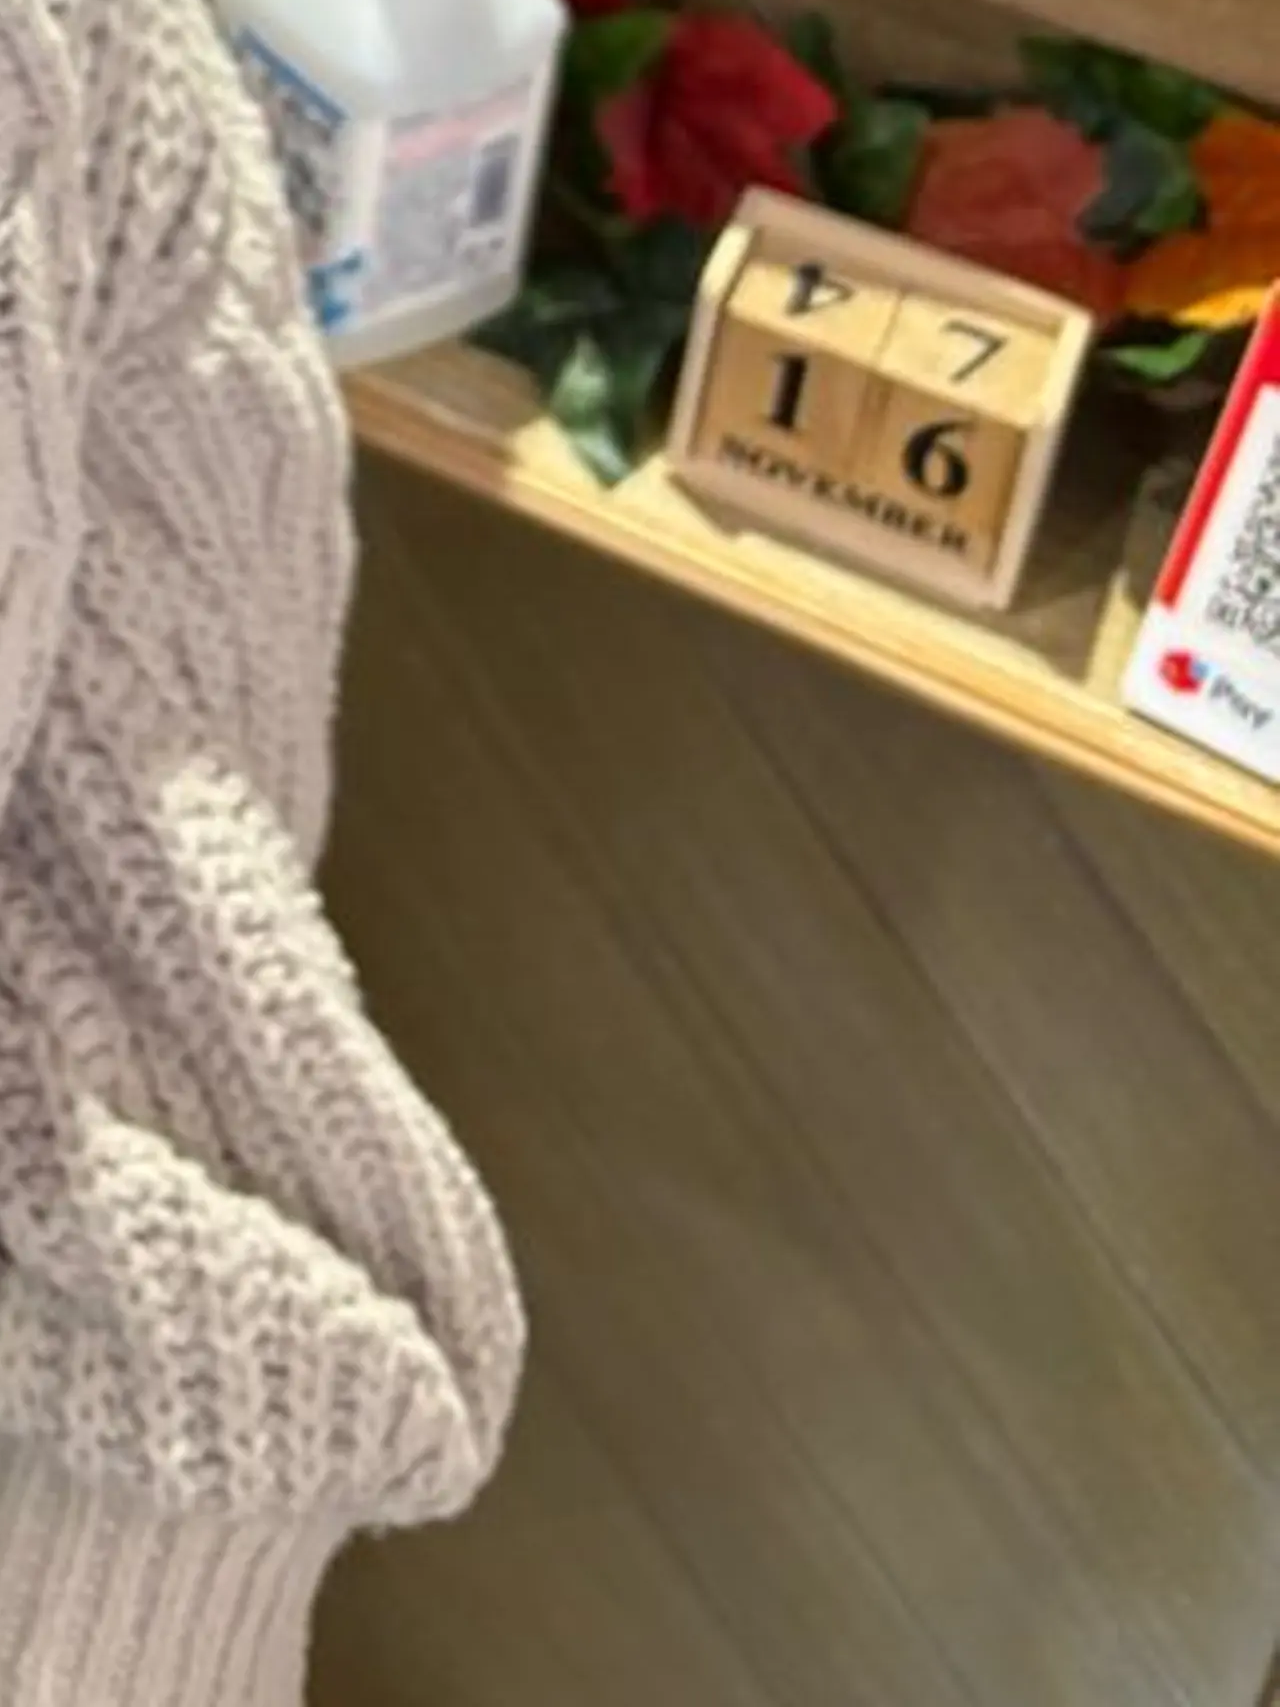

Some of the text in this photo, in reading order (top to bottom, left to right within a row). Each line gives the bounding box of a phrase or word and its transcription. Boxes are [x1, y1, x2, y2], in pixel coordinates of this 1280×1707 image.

[942, 319, 1008, 383] 7
[766, 353, 978, 502] 1 6
[719, 432, 969, 555] NOVEMBER
